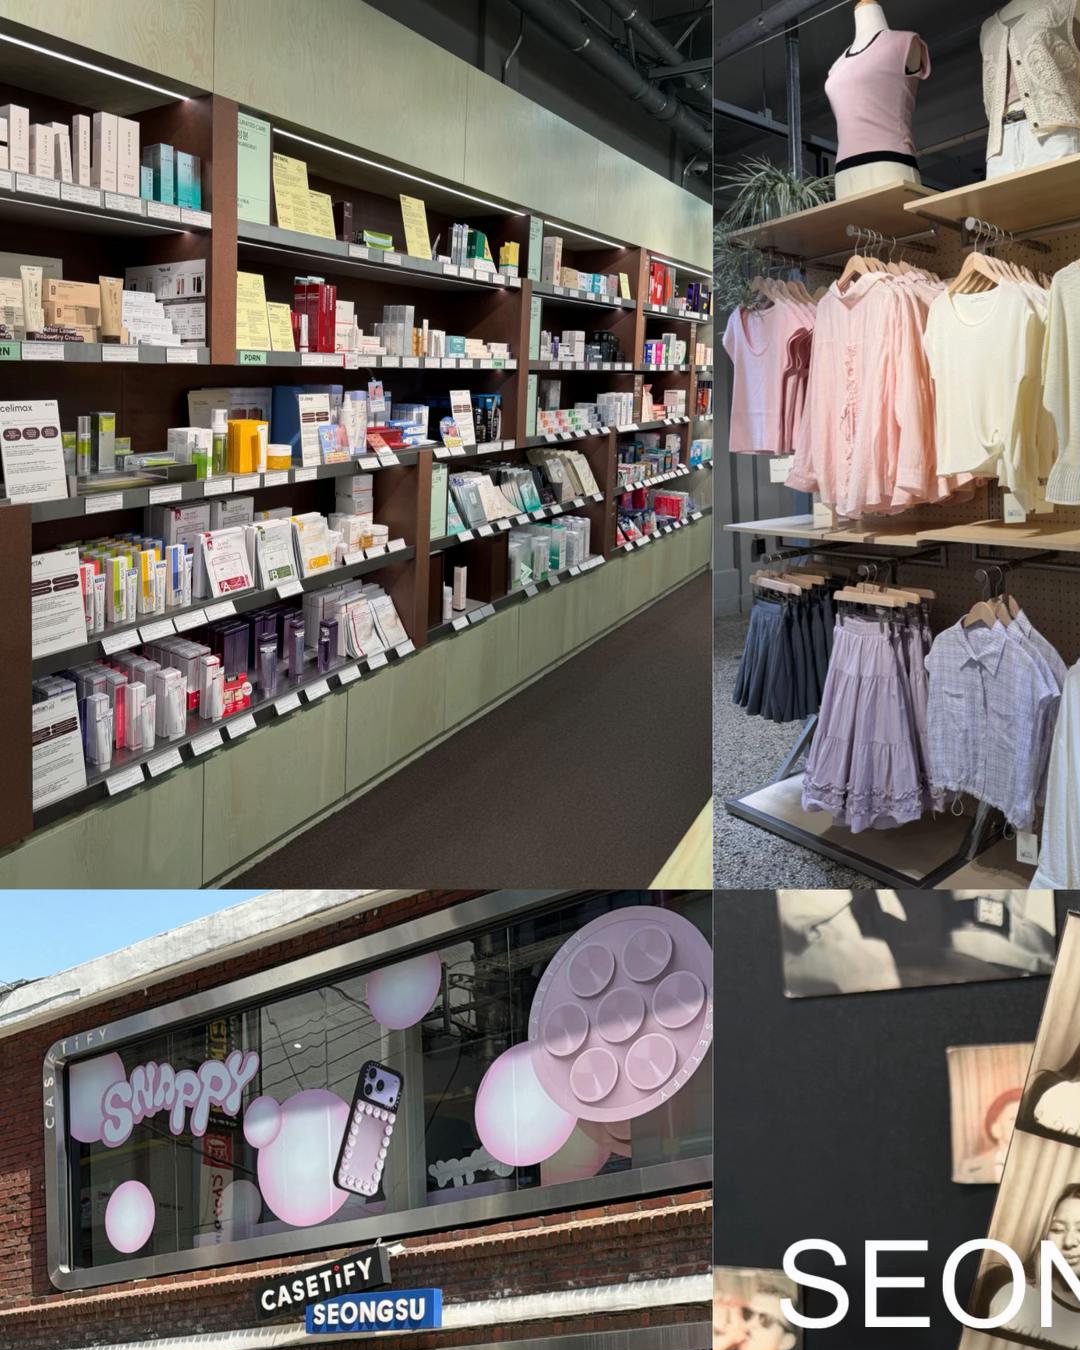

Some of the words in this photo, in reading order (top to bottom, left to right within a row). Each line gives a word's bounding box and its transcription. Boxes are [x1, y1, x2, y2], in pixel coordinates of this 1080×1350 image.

[244, 354, 261, 362] PDRN
[0, 404, 33, 413] celimax
[102, 1050, 260, 1148] SNAPPY
[313, 1297, 426, 1326] SEONGSU
